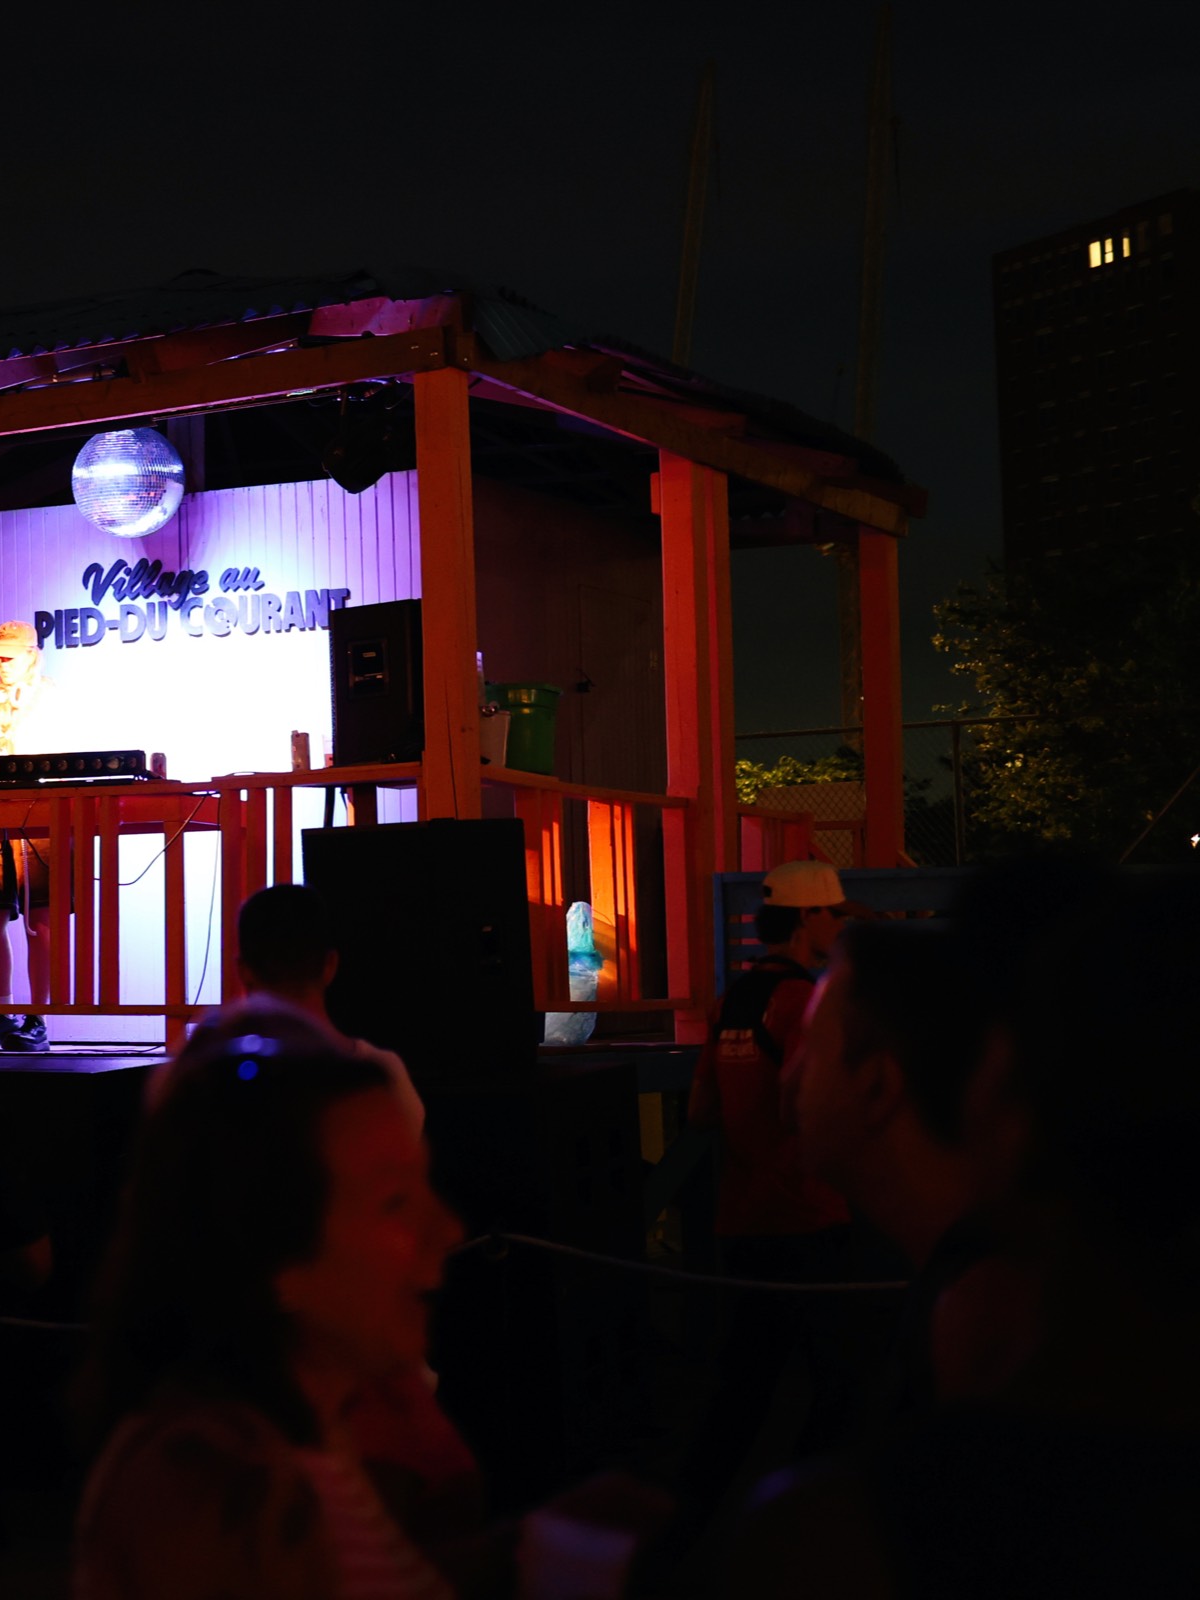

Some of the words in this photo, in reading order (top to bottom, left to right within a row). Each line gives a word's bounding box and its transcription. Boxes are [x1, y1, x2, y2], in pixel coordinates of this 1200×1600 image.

[82, 558, 210, 610] Village
[219, 567, 266, 593] au
[34, 600, 169, 650] PIED-DU
